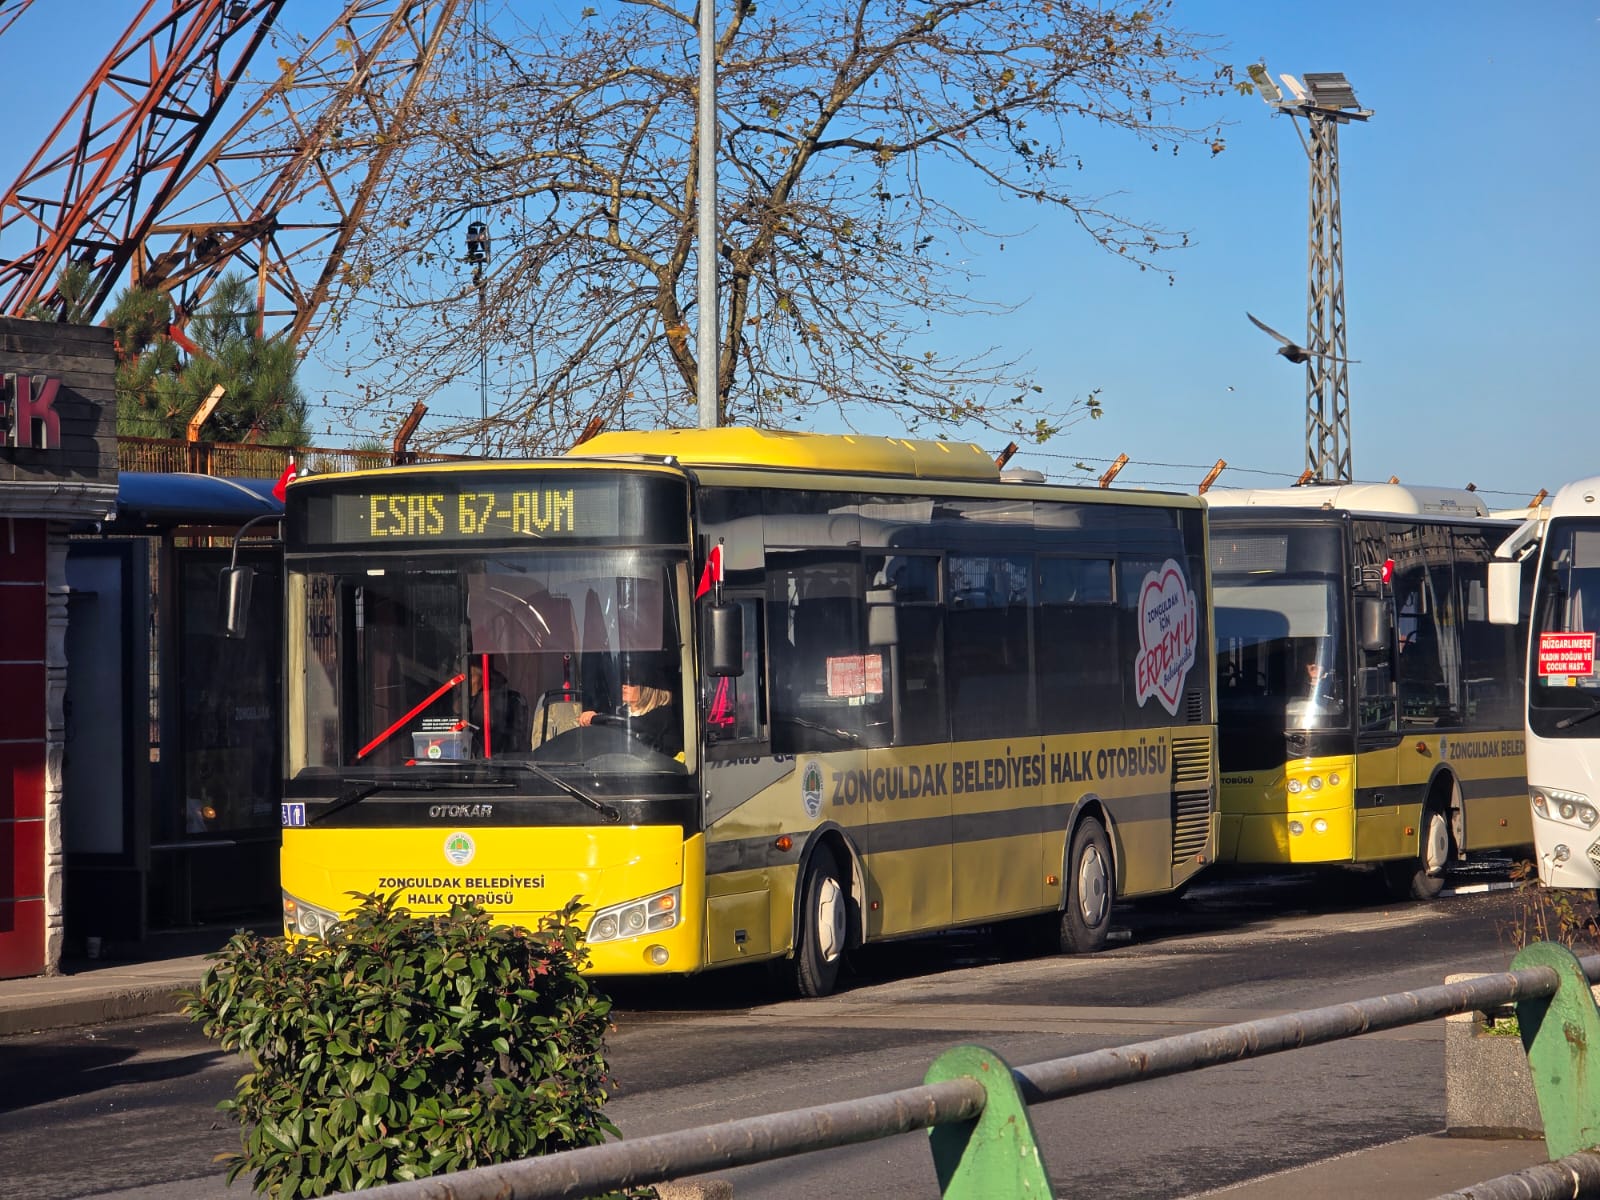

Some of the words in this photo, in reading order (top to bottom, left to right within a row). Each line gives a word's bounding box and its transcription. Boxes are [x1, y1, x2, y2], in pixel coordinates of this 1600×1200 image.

[0, 373, 61, 449] K
[370, 494, 444, 536] ESAS
[458, 489, 574, 534] 67-AVM
[1147, 592, 1179, 623] ZONGULDAK
[1542, 637, 1591, 651] RÜZGARLIMEŞE
[1541, 653, 1559, 661] KADIN
[1561, 651, 1582, 661] DOĞUM
[1584, 652, 1592, 661] VE
[1546, 663, 1567, 672] ÇOCUK
[1450, 740, 1499, 759] ZONGULDAK
[832, 762, 948, 806] ZONGULDAK
[952, 742, 1046, 795] BELEDİYESİ
[1050, 750, 1093, 784] HALK
[1097, 737, 1167, 780] OTOBÜSÜ
[429, 804, 493, 818] OTOKAR
[379, 877, 461, 889] ZONGULDAK
[465, 874, 545, 889] BELEDİYESİ
[408, 893, 443, 905] HALK
